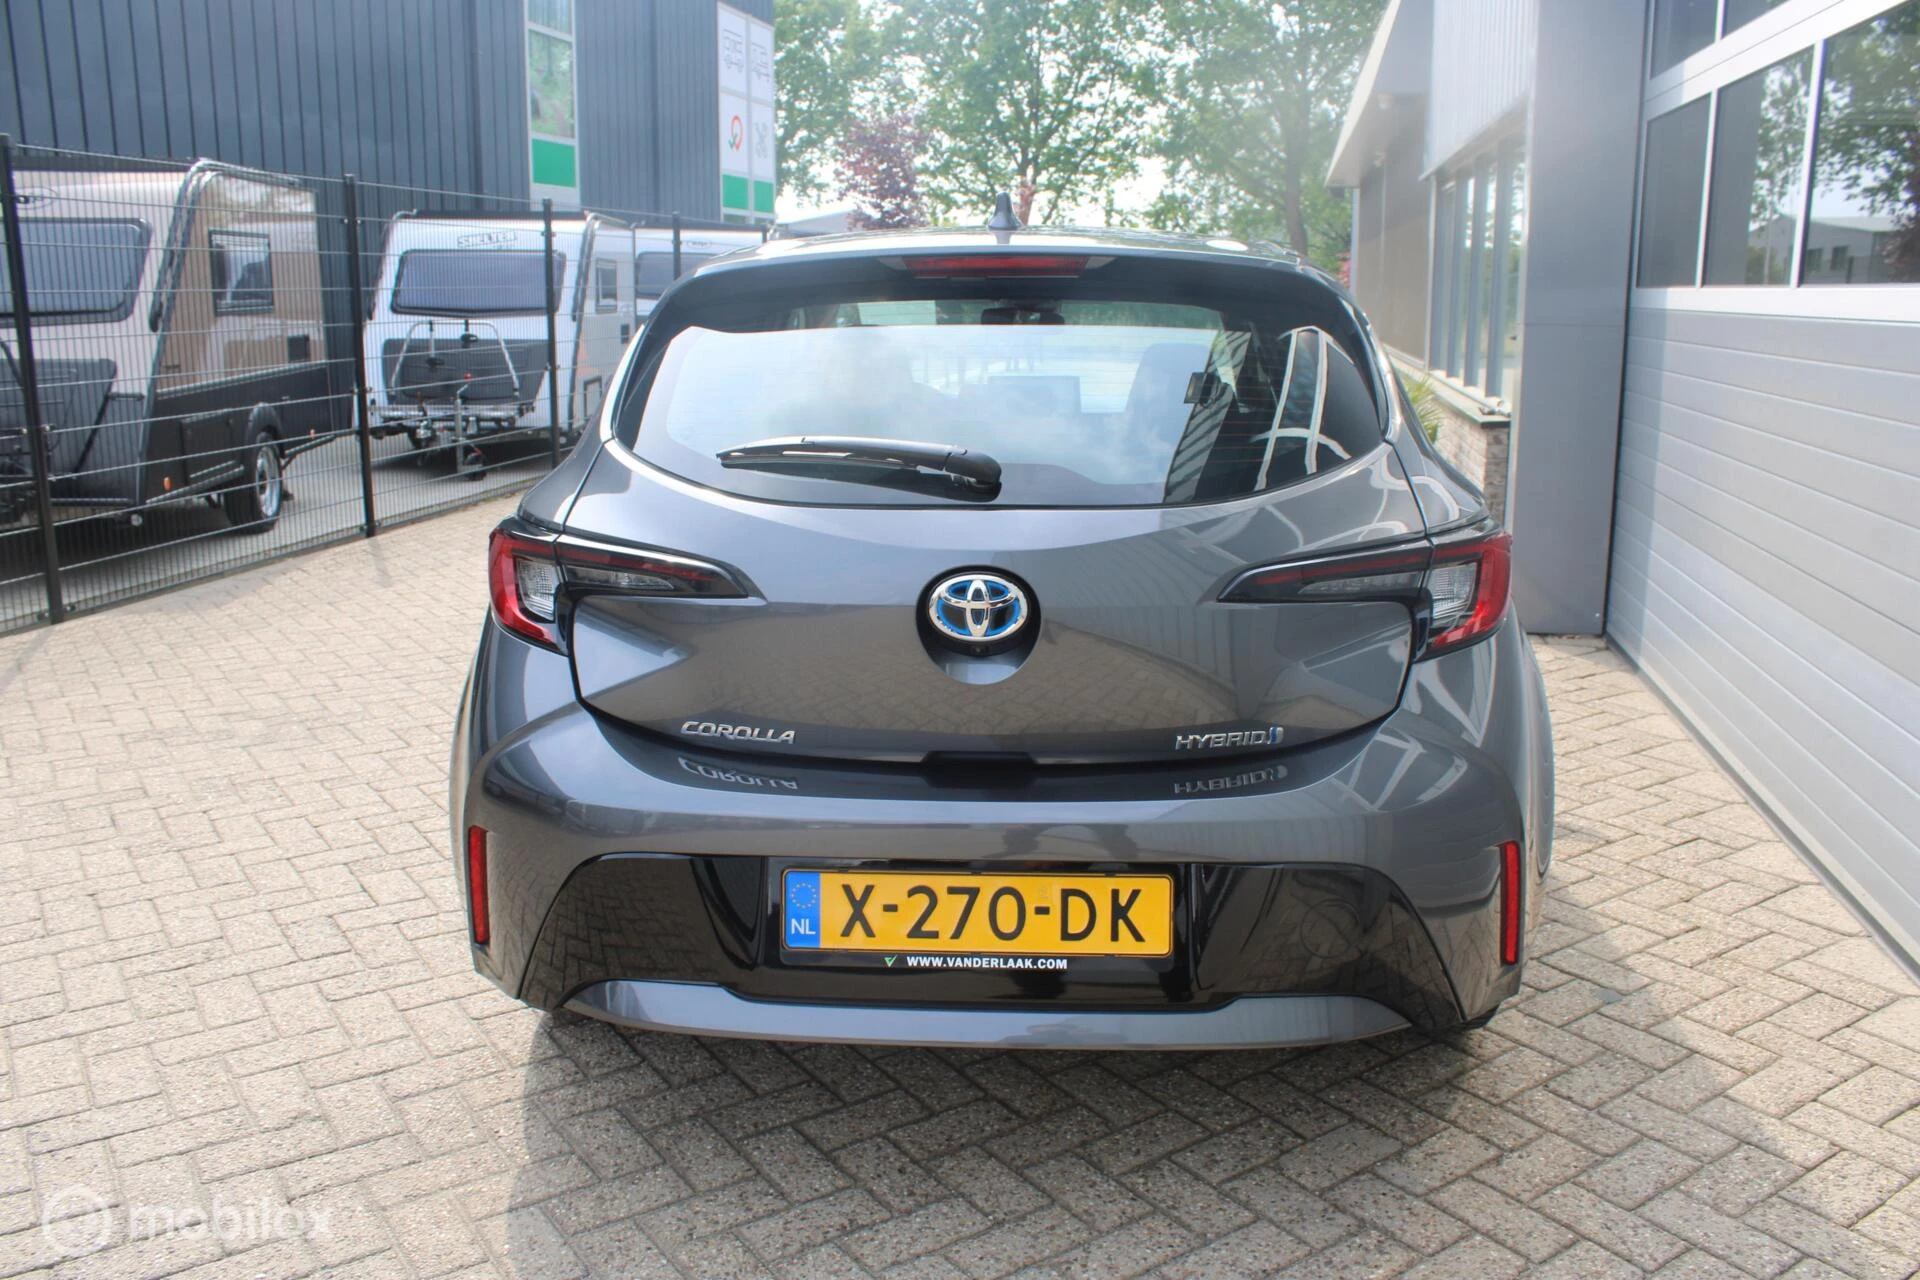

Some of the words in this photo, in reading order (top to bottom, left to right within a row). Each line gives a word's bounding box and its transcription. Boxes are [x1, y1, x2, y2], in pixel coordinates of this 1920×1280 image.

[680, 721, 796, 745] COROLLA
[1175, 730, 1267, 750] HYBRID
[840, 883, 1146, 943] X-270-DK
[790, 918, 816, 935] NL
[906, 956, 1067, 970] WWW.VANDERLAAK.COM
